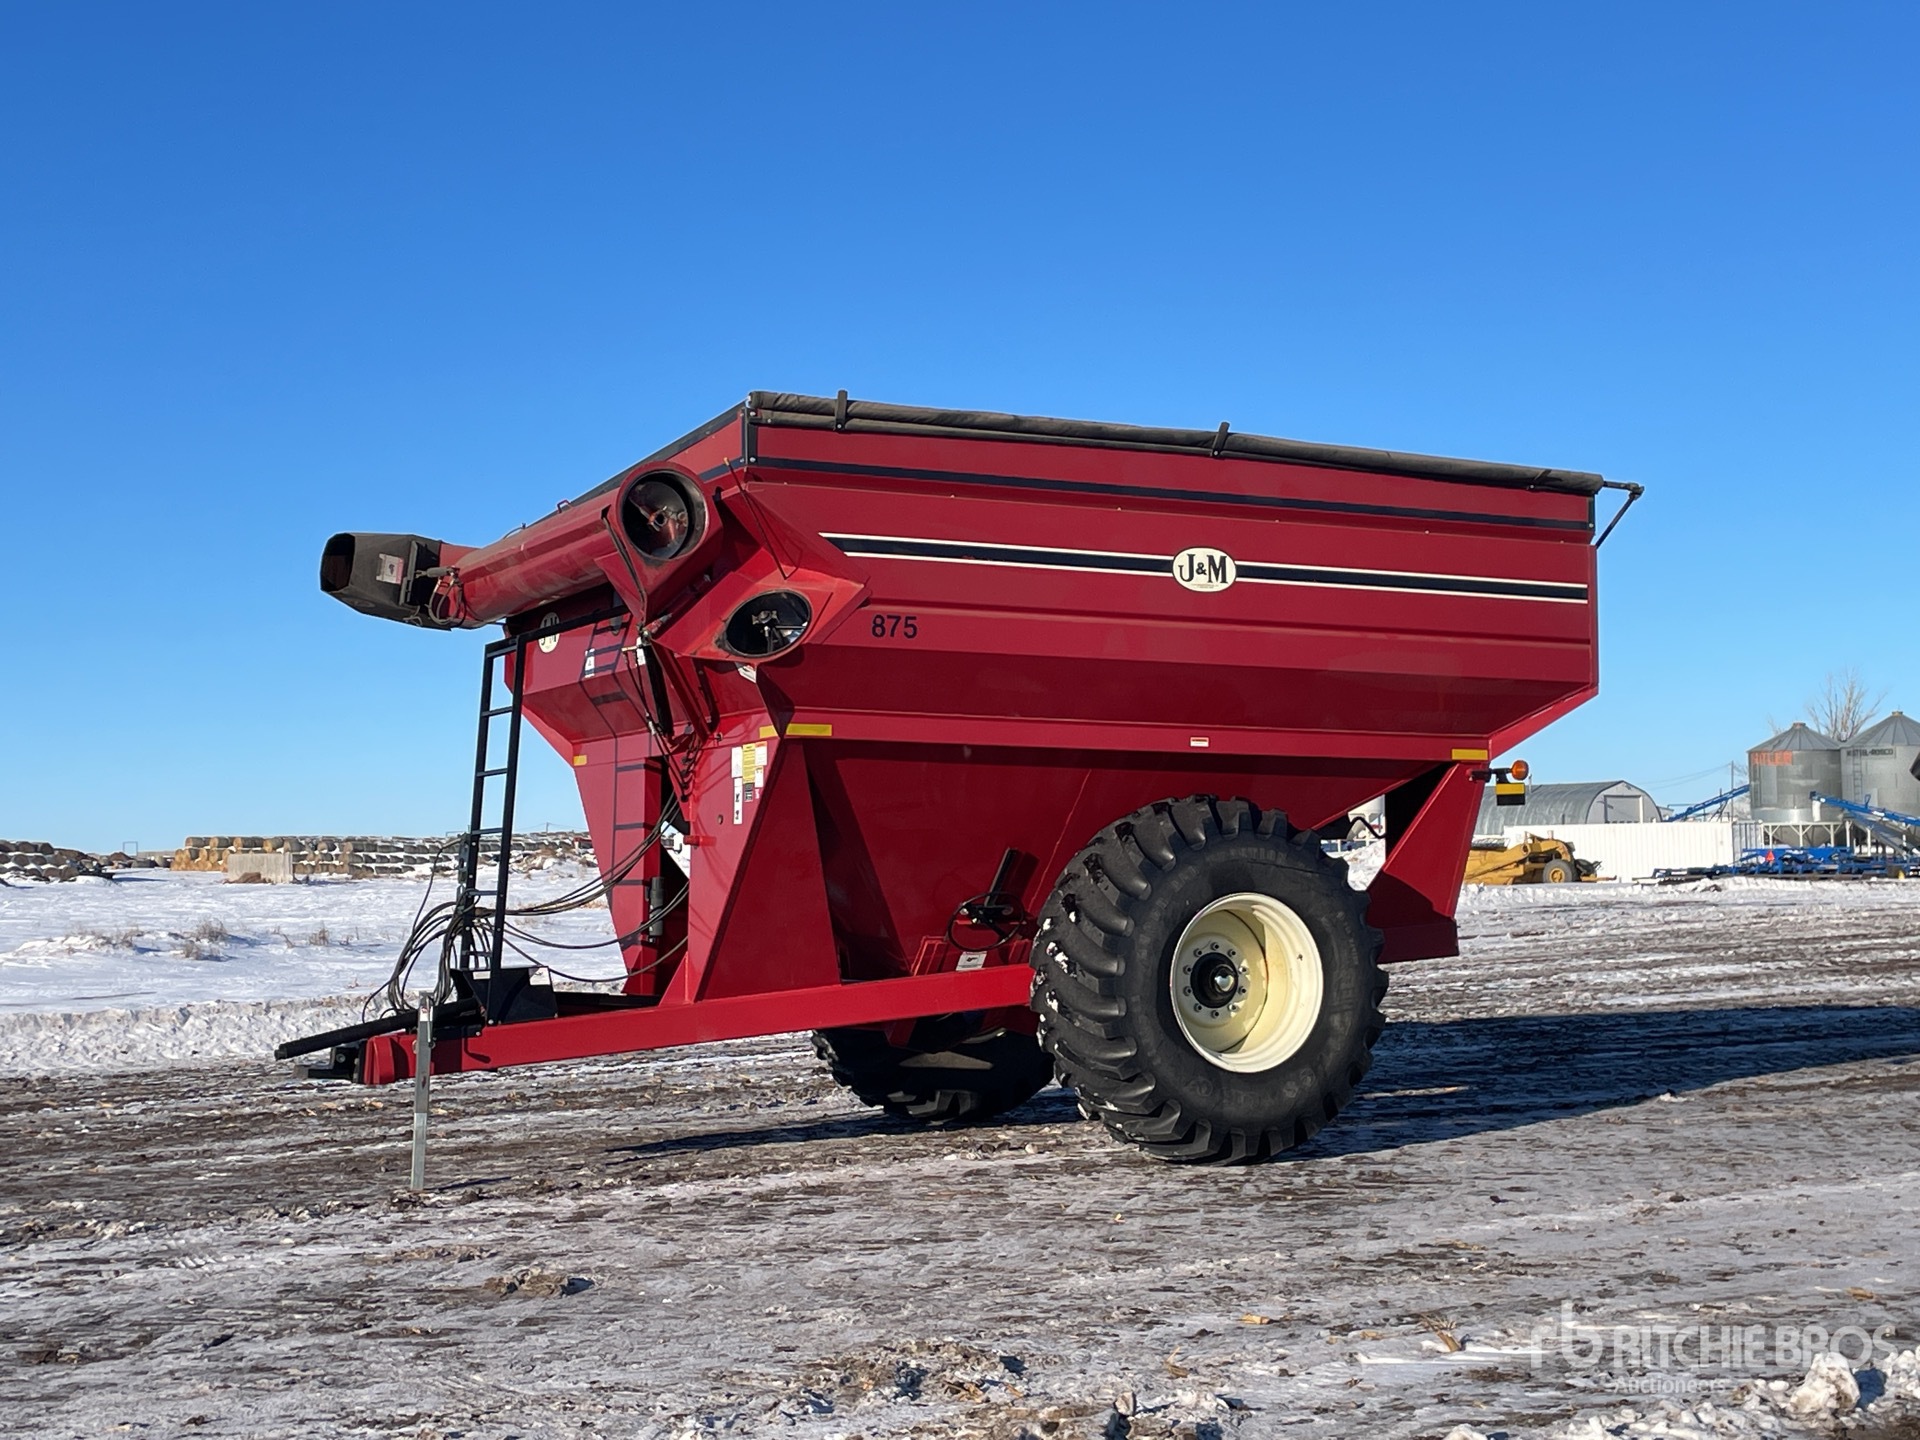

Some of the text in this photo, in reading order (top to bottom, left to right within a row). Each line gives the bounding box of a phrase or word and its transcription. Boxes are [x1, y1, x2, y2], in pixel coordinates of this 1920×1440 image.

[1178, 553, 1228, 584] J&M
[540, 616, 559, 646] JM
[871, 613, 918, 639] 875
